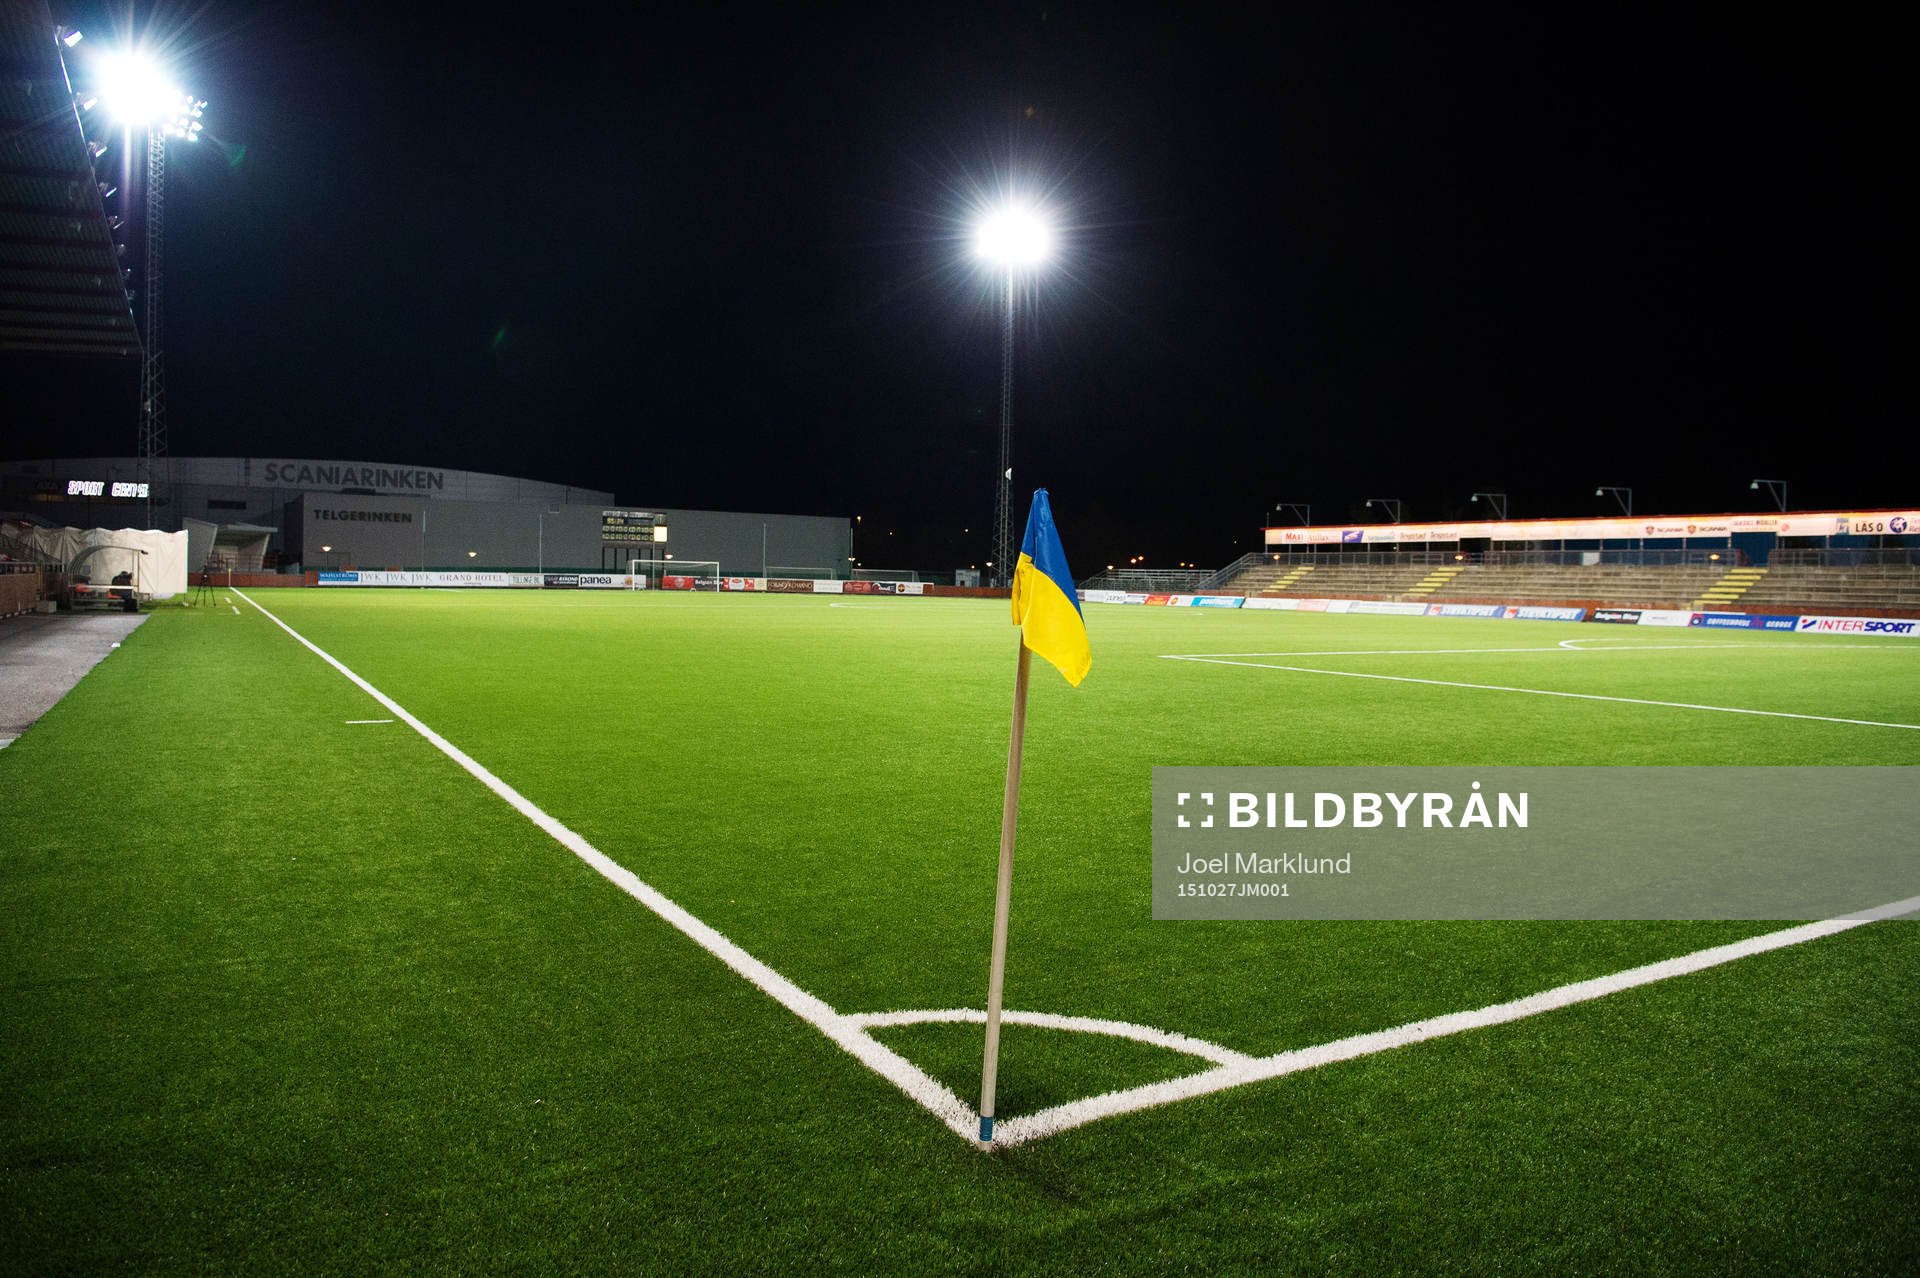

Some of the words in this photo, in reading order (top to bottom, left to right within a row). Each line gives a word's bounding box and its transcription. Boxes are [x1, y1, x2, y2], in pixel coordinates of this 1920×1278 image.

[264, 462, 444, 490] SCANIARINKEN
[313, 509, 412, 523] TELGERINKEN
[439, 574, 472, 583] GRAND
[475, 574, 504, 582] HOTEL
[580, 576, 612, 585] panea
[1818, 619, 1916, 633] INTERSPORT
